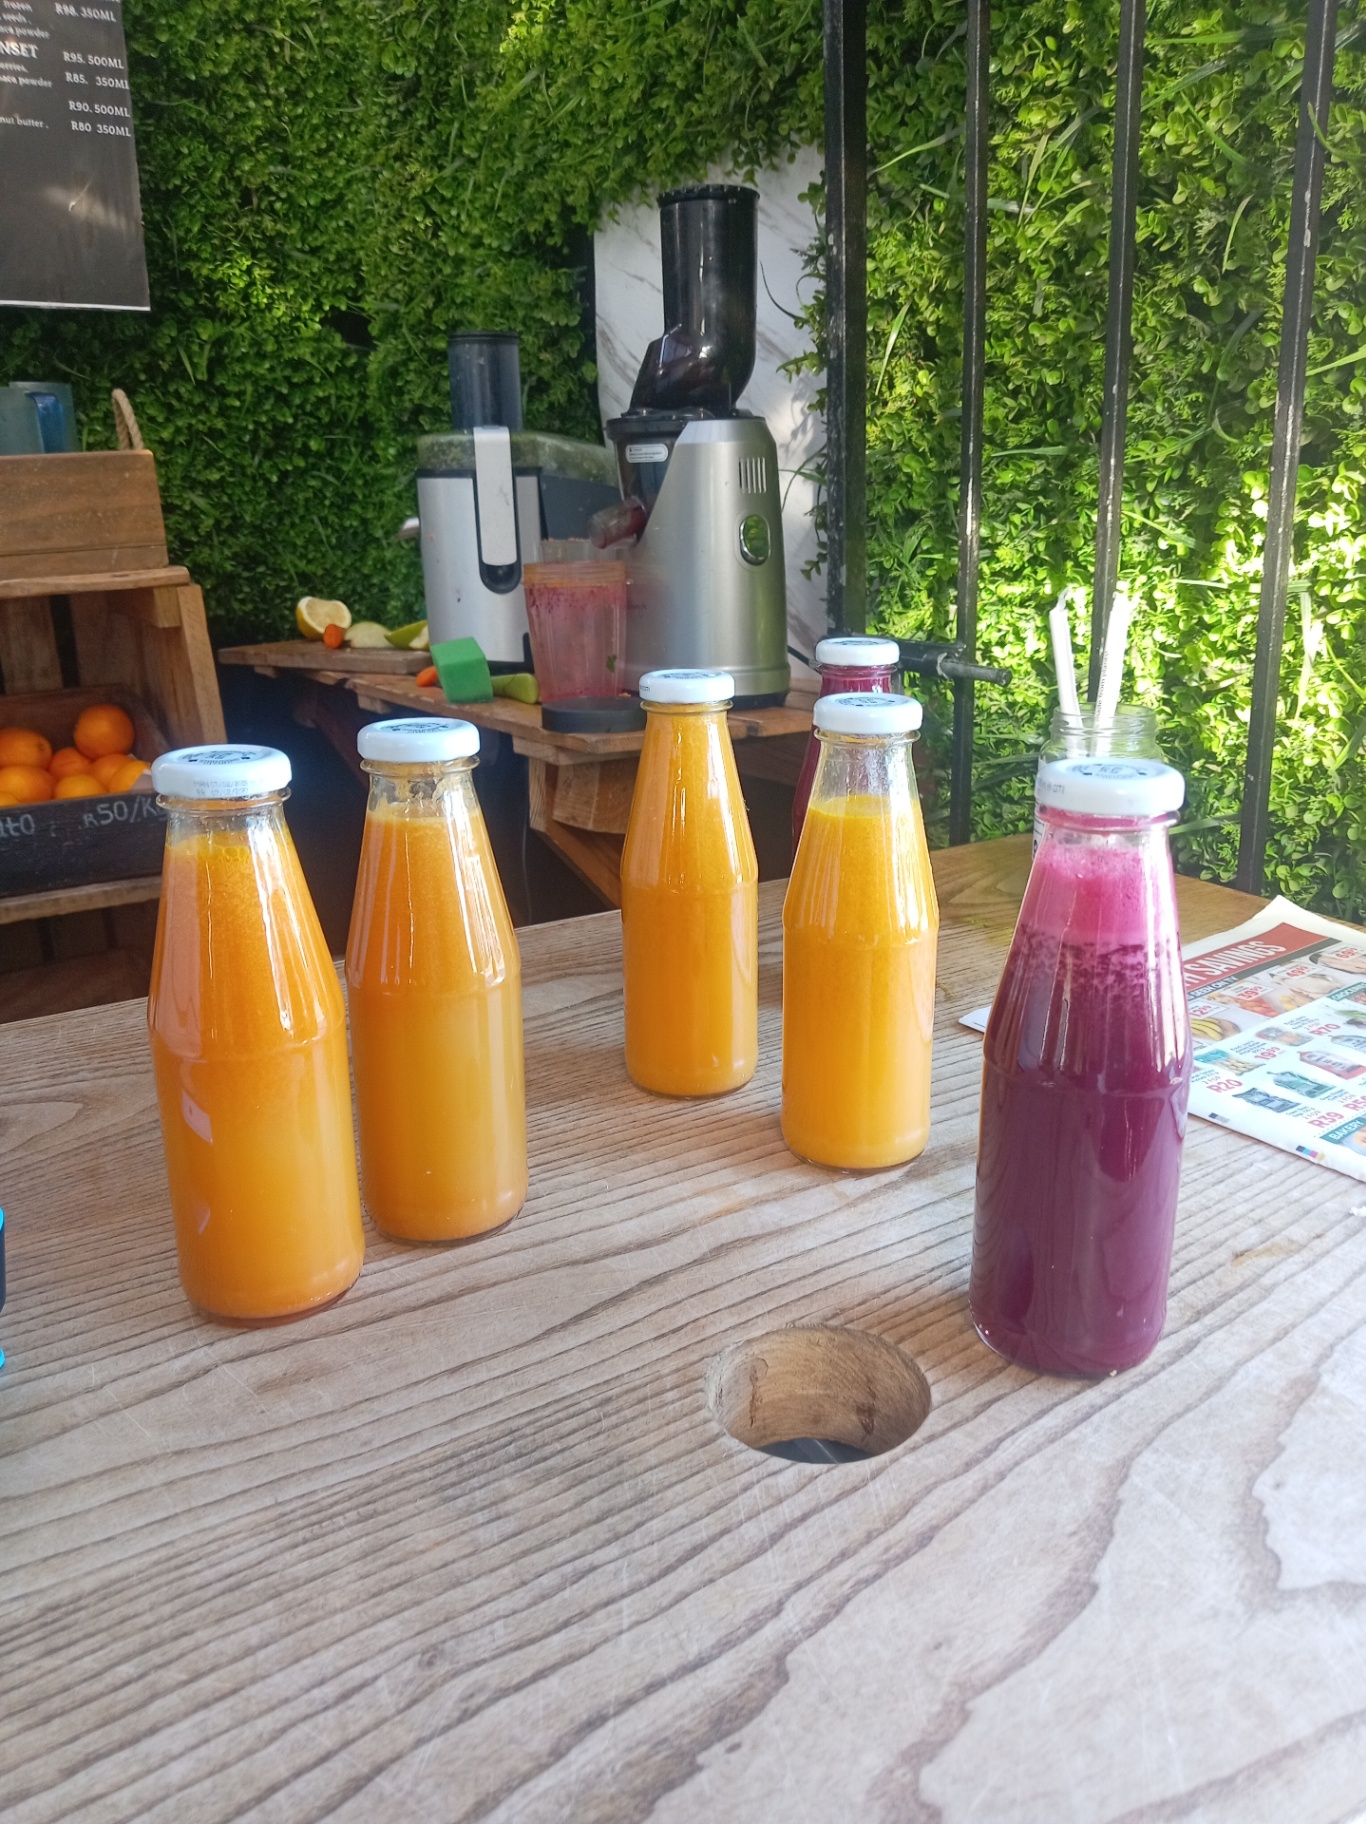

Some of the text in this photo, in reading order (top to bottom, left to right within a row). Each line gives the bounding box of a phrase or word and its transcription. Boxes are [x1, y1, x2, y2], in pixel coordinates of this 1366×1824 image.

[88, 55, 125, 69] 500ML
[18, 76, 52, 88] powder
[95, 105, 131, 118] 500ML
[71, 121, 131, 137] R80 350ML
[1194, 940, 1287, 976] SAVINGS
[1308, 1023, 1341, 1036] R70
[1206, 1077, 1242, 1094] R20
[1307, 1111, 1345, 1128] R39
[1328, 1118, 1364, 1141] BAKERY
